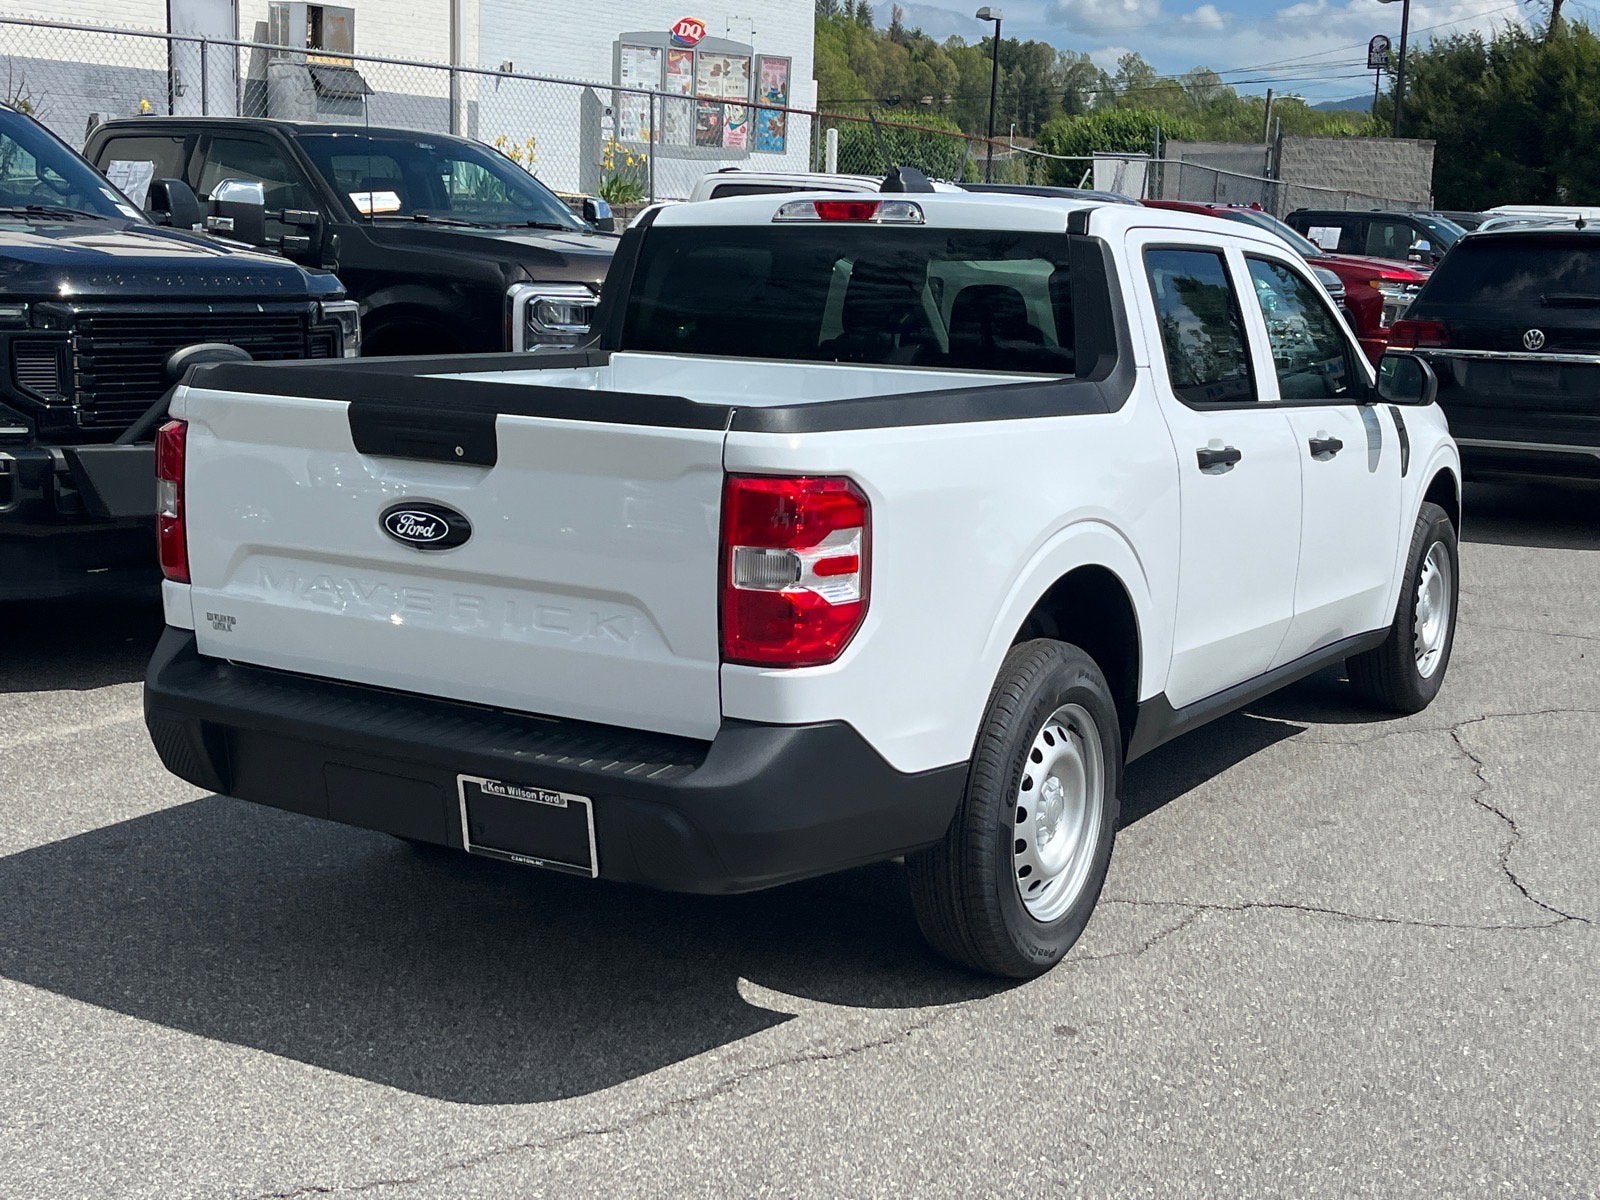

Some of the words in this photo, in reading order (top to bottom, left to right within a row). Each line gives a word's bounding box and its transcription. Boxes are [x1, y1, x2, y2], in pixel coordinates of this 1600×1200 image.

[678, 22, 702, 41] DQ
[396, 513, 437, 538] Ford
[257, 563, 631, 645] MAVERICK
[488, 782, 505, 793] Ken
[507, 786, 537, 799] Wilson
[539, 791, 560, 804] Ford
